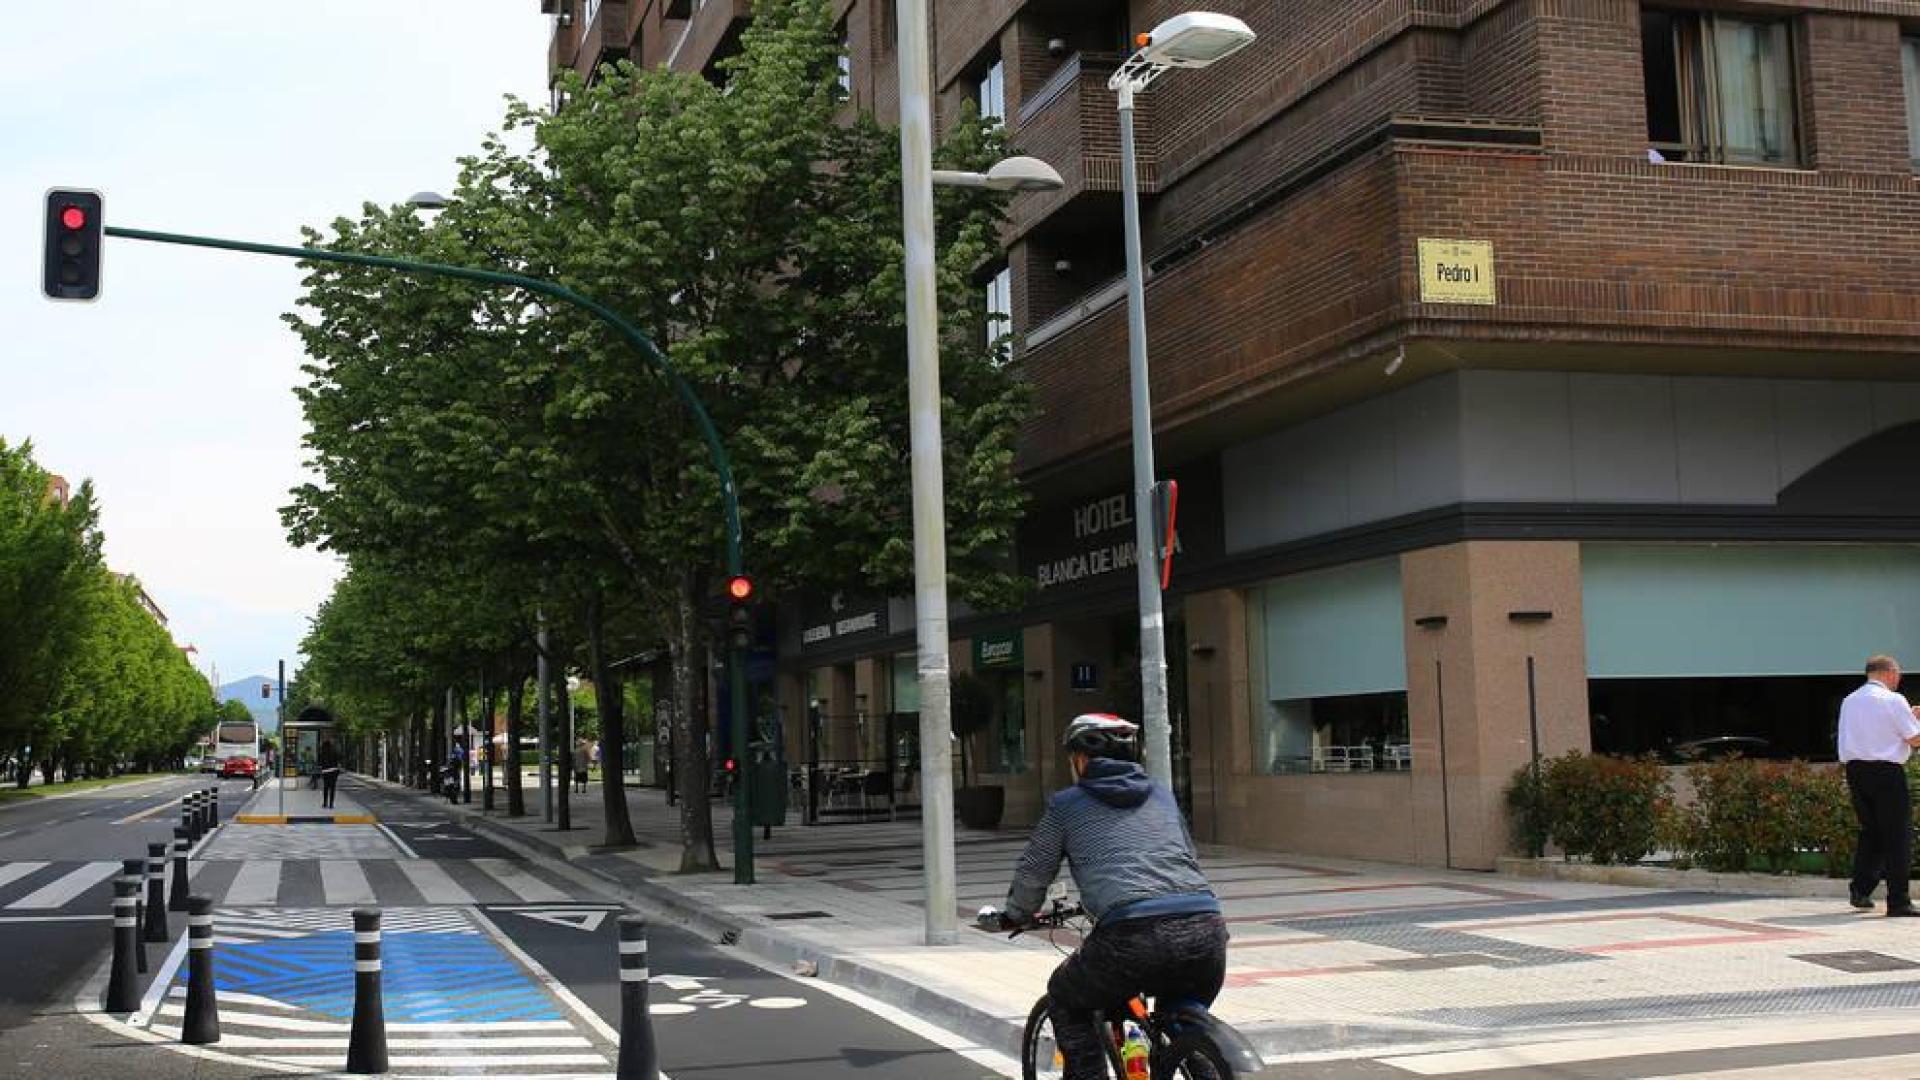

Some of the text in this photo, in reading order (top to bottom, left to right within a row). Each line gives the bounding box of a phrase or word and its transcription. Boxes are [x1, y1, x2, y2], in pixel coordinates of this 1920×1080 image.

[1436, 263, 1471, 283] Pedro
[1074, 494, 1133, 538] HOTEL
[1038, 554, 1089, 587] BLANCA
[1089, 548, 1113, 575] DE
